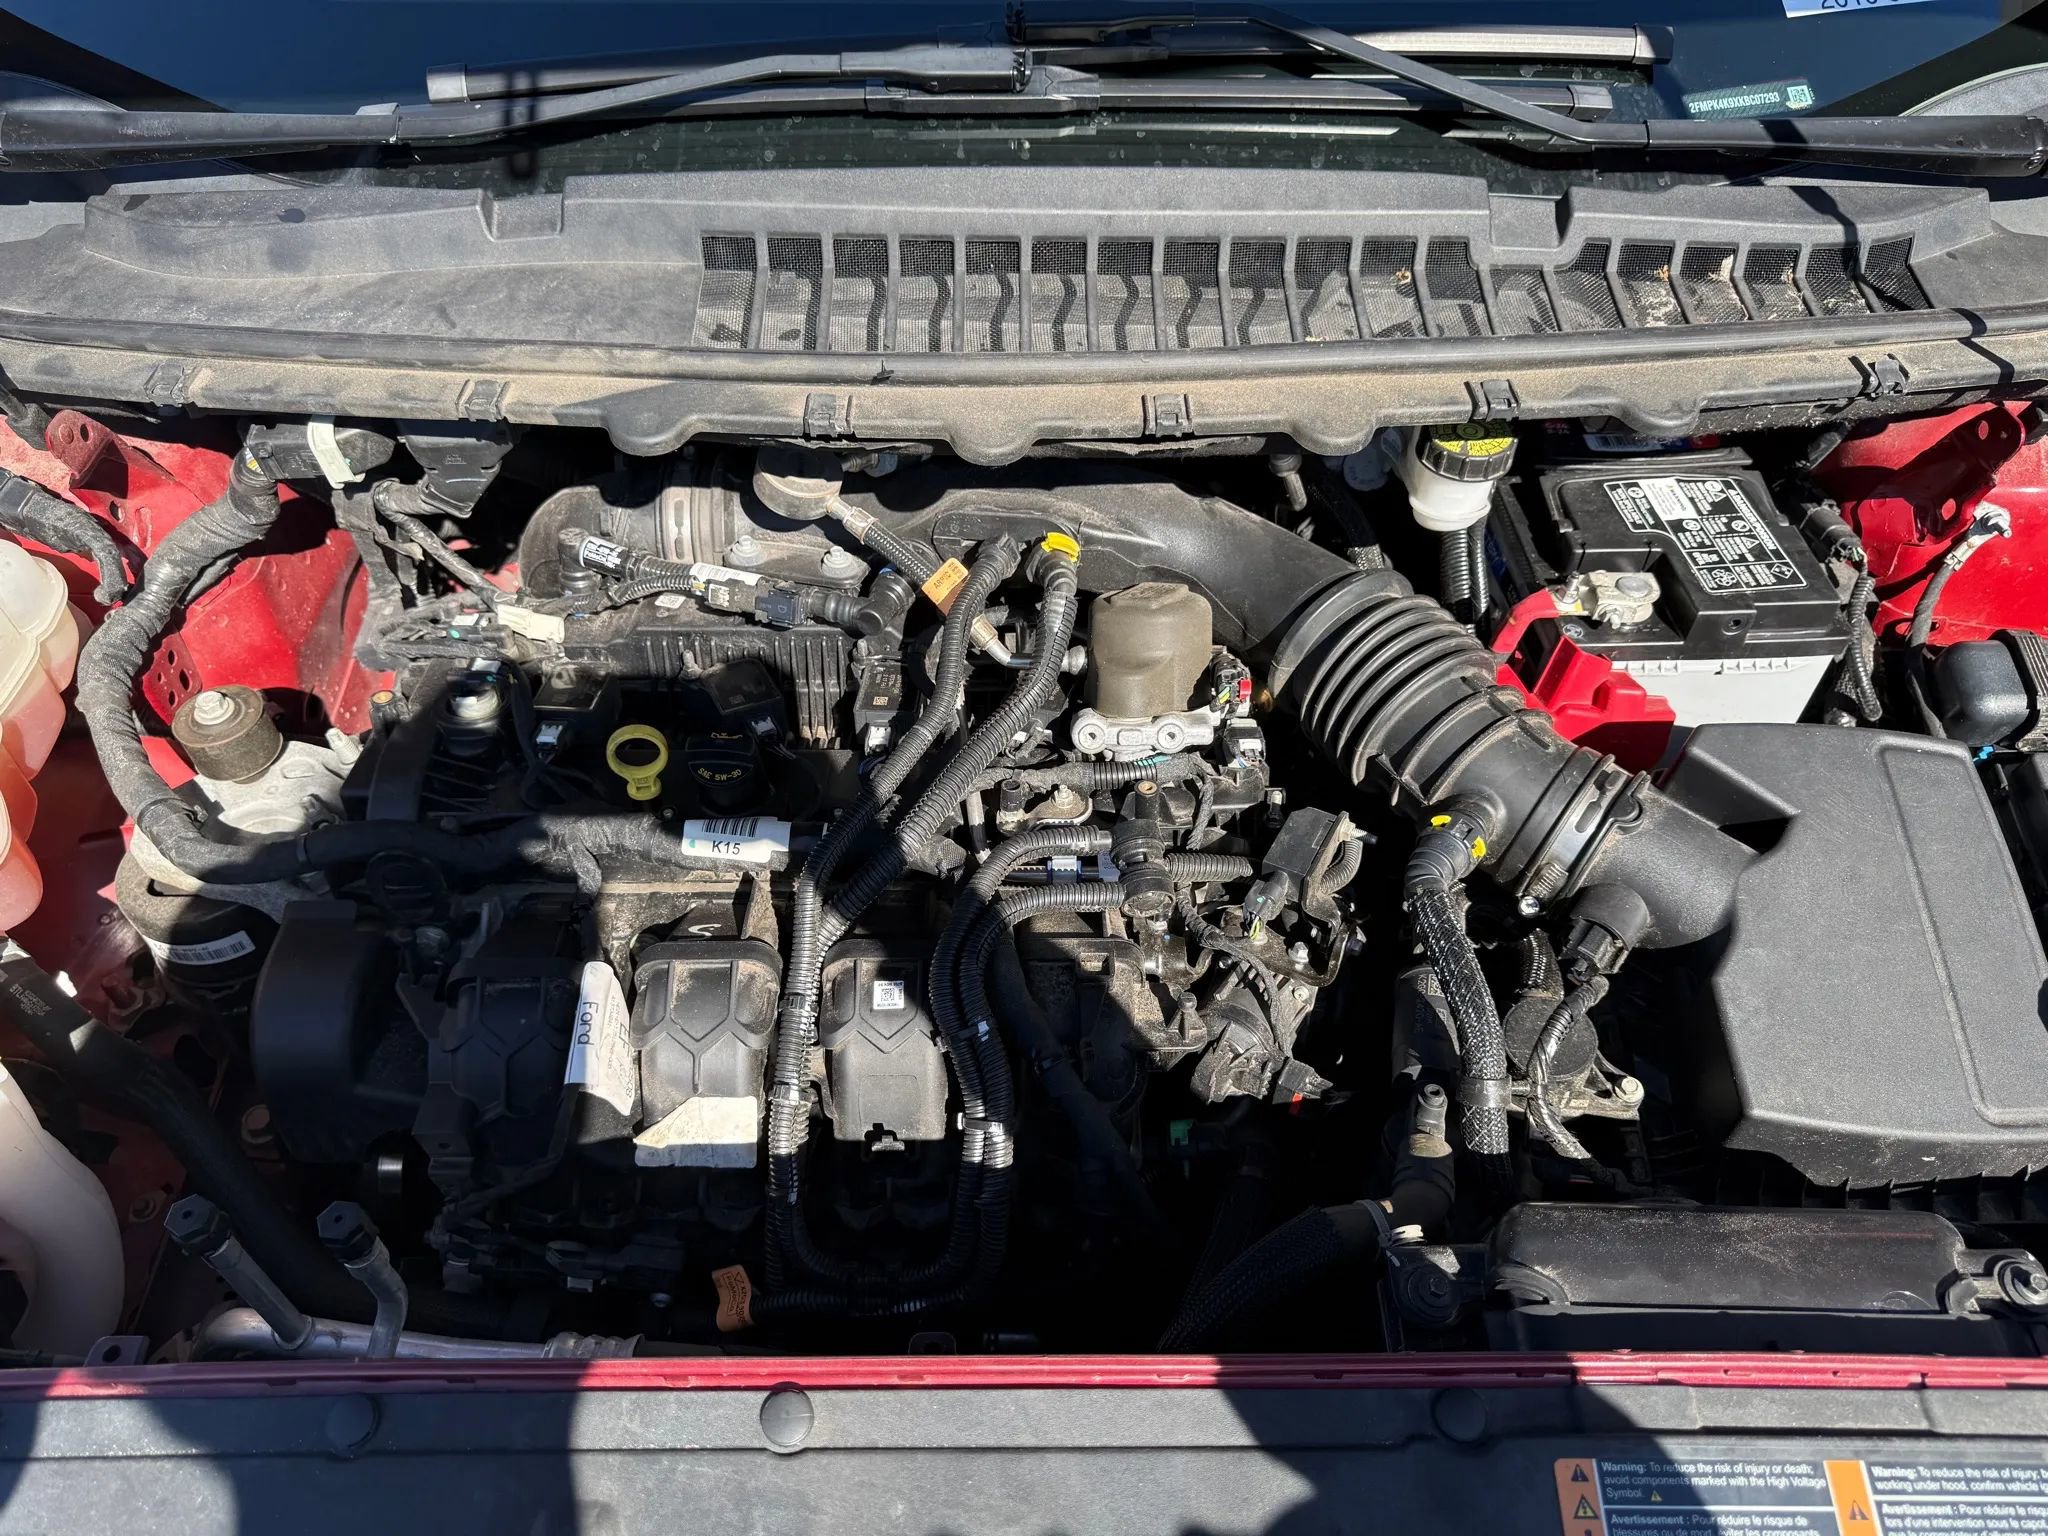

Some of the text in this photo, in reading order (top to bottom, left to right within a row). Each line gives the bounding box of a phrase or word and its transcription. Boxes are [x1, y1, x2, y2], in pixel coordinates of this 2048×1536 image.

[1688, 91, 1780, 114] 2FMPK4K9XKBC07293
[697, 767, 742, 781] SAE 5W-30
[712, 840, 741, 855] K15
[577, 1001, 600, 1046] Ford
[1601, 1462, 1647, 1473] Warning:
[1650, 1462, 1661, 1472] To
[1663, 1463, 1696, 1473] reduce
[1697, 1463, 1712, 1473] the
[1714, 1463, 1731, 1473] risk
[1733, 1463, 1743, 1473] of
[1744, 1463, 1770, 1475] injury
[1772, 1465, 1782, 1474] or
[1917, 1466, 1931, 1477] To
[1931, 1467, 1964, 1478] reduce
[1963, 1467, 1981, 1478] the
[1982, 1467, 2000, 1478] risk
[2000, 1468, 2010, 1478] of
[1604, 1475, 1826, 1489] avoid components marked with the High Voltage
[1874, 1479, 1913, 1492] working
[1913, 1480, 1940, 1490] under
[1970, 1480, 2005, 1491] confirm
[2005, 1481, 2039, 1491] vehicle
[1882, 1503, 1953, 1515] Avertissement
[1958, 1503, 1982, 1515] Pour
[2016, 1504, 2026, 1516] le
[2027, 1505, 2048, 1517] risqu
[1611, 1514, 1684, 1525] Avertissement
[1692, 1514, 1716, 1525] Pour
[1751, 1514, 1762, 1526] le
[1763, 1515, 1792, 1527] risque
[1794, 1515, 1808, 1526] de
[1986, 1518, 2009, 1529] sous
[2009, 1517, 2019, 1529] le
